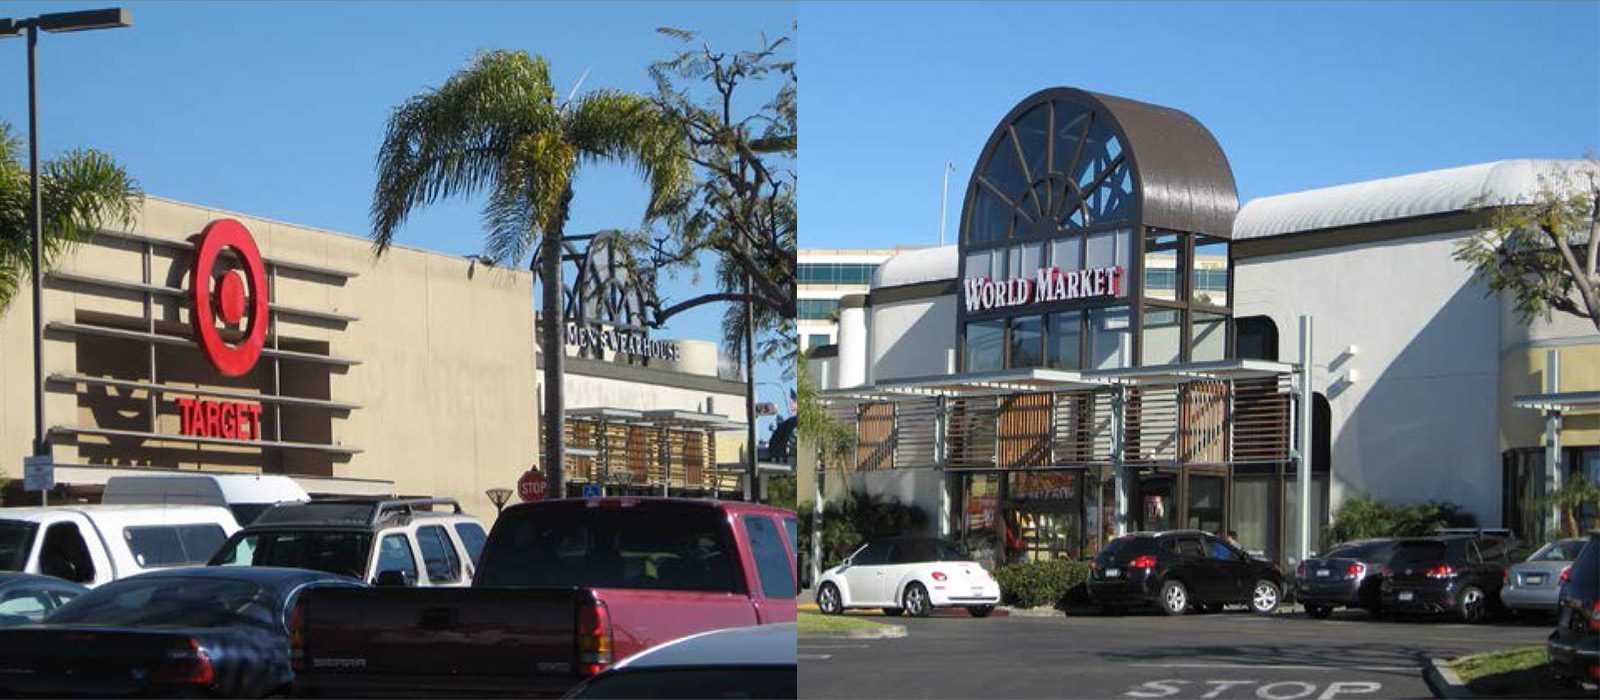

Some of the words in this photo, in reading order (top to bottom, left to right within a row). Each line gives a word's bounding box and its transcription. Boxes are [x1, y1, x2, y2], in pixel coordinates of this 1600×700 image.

[964, 277, 1030, 311] WORLD
[1034, 266, 1120, 303] MARKET
[608, 329, 682, 362] WEARHOUSE
[175, 397, 262, 440] TARGET
[522, 481, 547, 495] STOP
[313, 658, 367, 669] SIERRA
[1124, 679, 1382, 700] STOP
